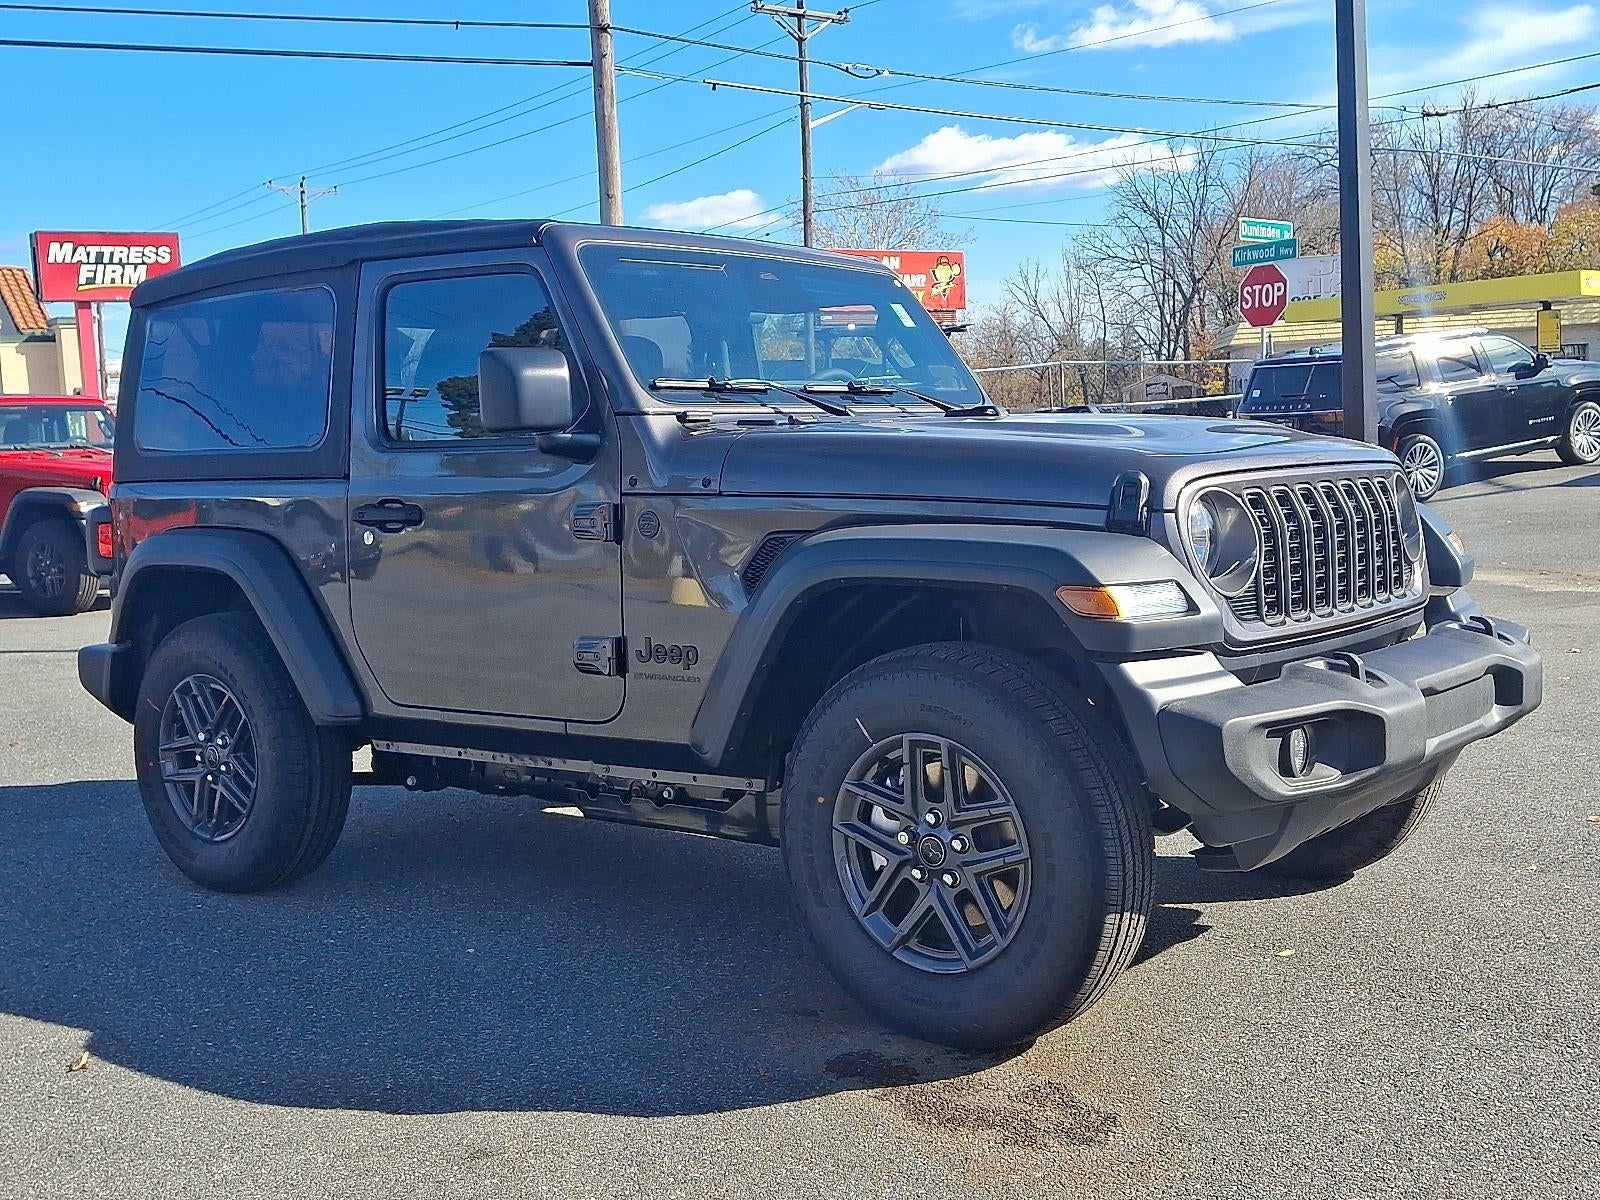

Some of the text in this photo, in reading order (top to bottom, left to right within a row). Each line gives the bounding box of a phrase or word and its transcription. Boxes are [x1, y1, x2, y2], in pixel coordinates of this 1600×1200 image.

[1241, 222, 1280, 239] Dunlinden
[47, 241, 172, 264] MATTRESS
[1234, 244, 1294, 262] Kirkwood Hwy
[78, 263, 148, 285] FIRM
[898, 272, 927, 288] AN?
[1242, 282, 1284, 310] STOP
[635, 636, 699, 671] Jeep
[643, 672, 702, 684] WRANGLER
